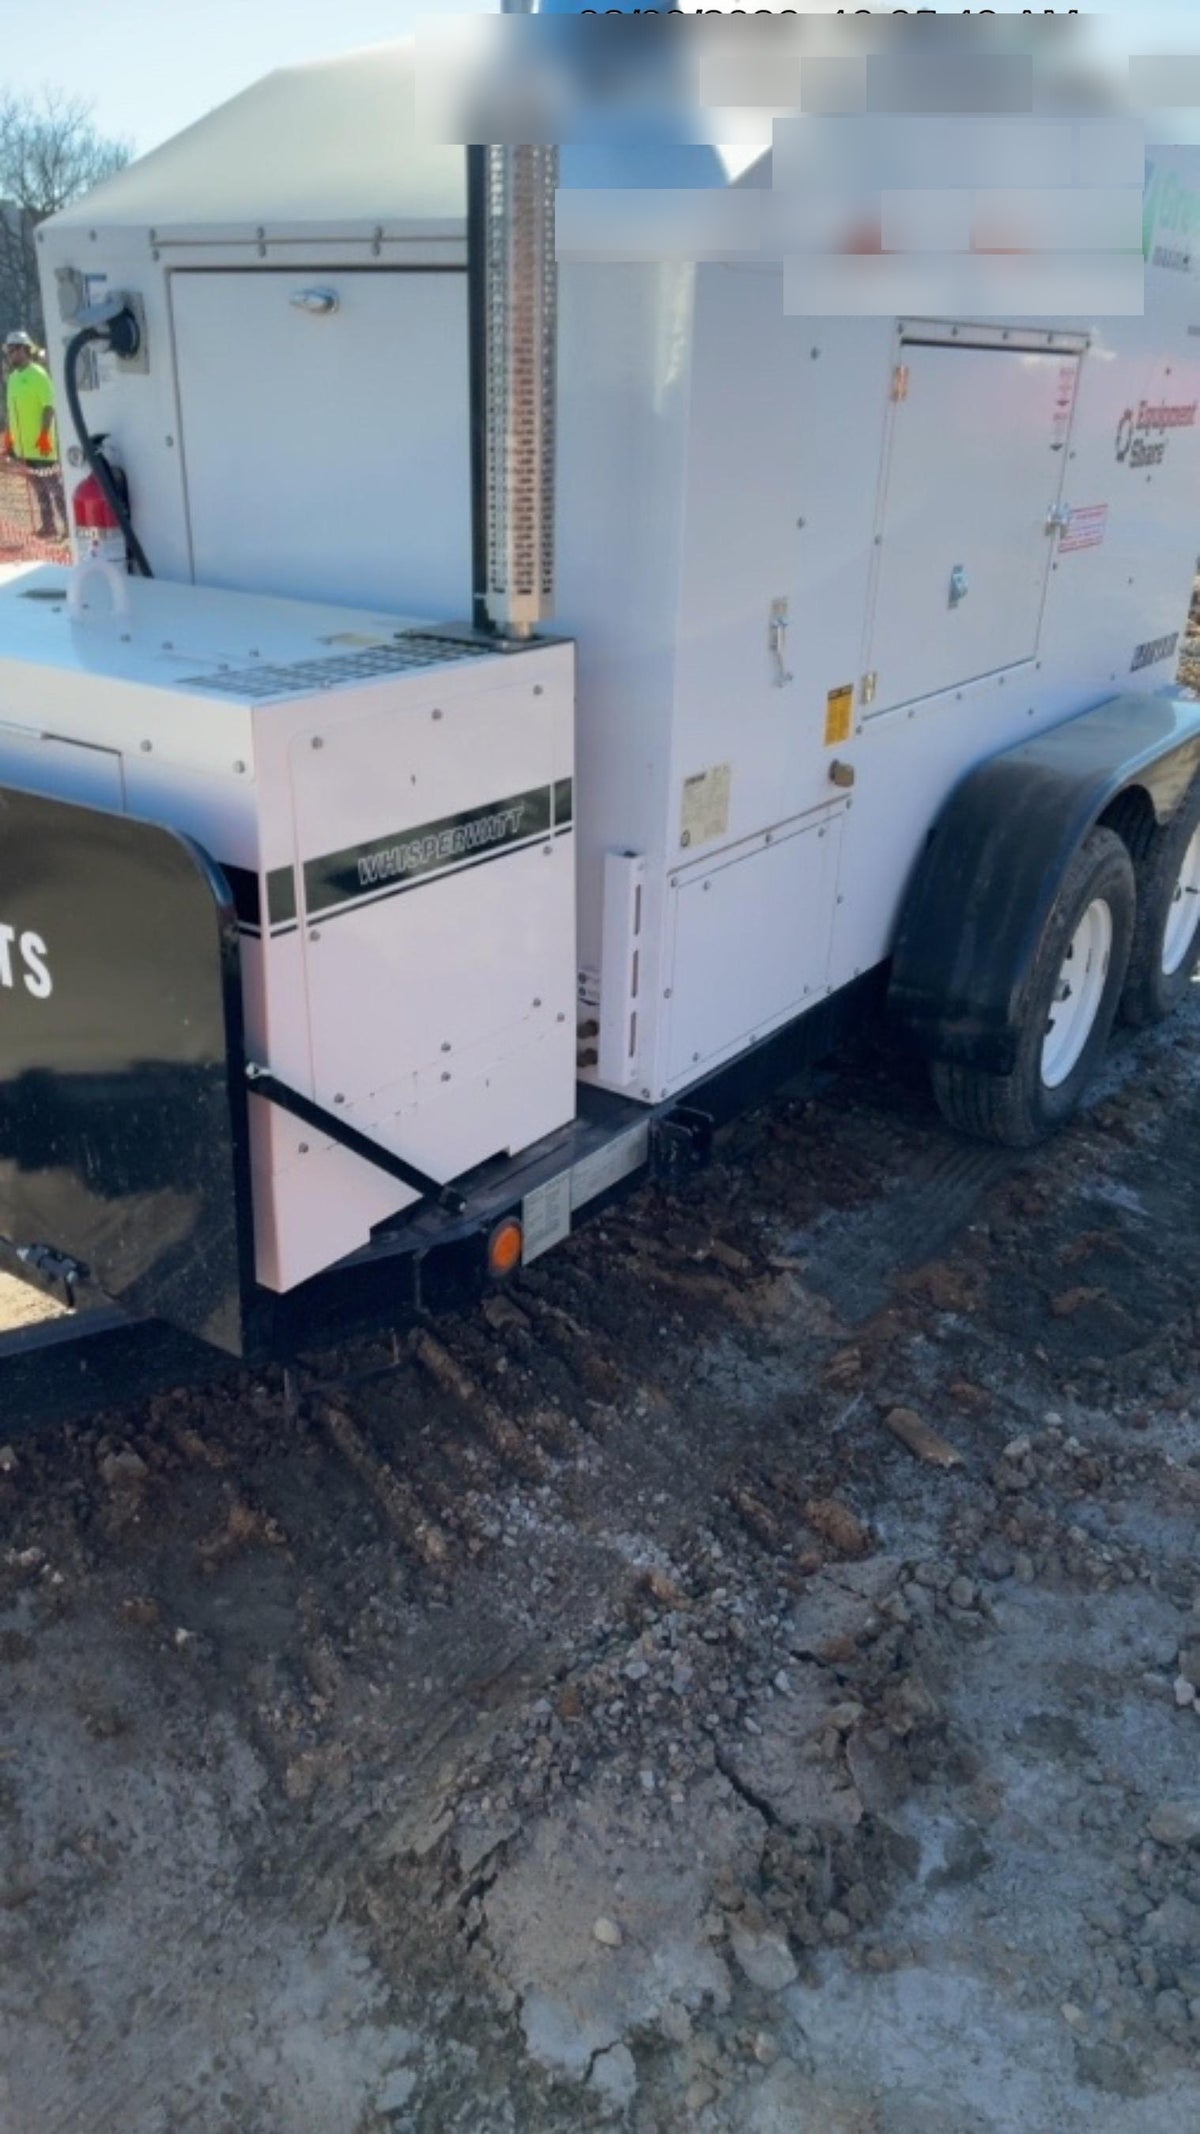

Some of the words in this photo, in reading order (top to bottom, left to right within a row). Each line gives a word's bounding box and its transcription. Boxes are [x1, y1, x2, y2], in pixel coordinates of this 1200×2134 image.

[1136, 399, 1197, 436] Equipment
[1129, 438, 1165, 468] Share
[357, 801, 525, 885] WHISPERWATT
